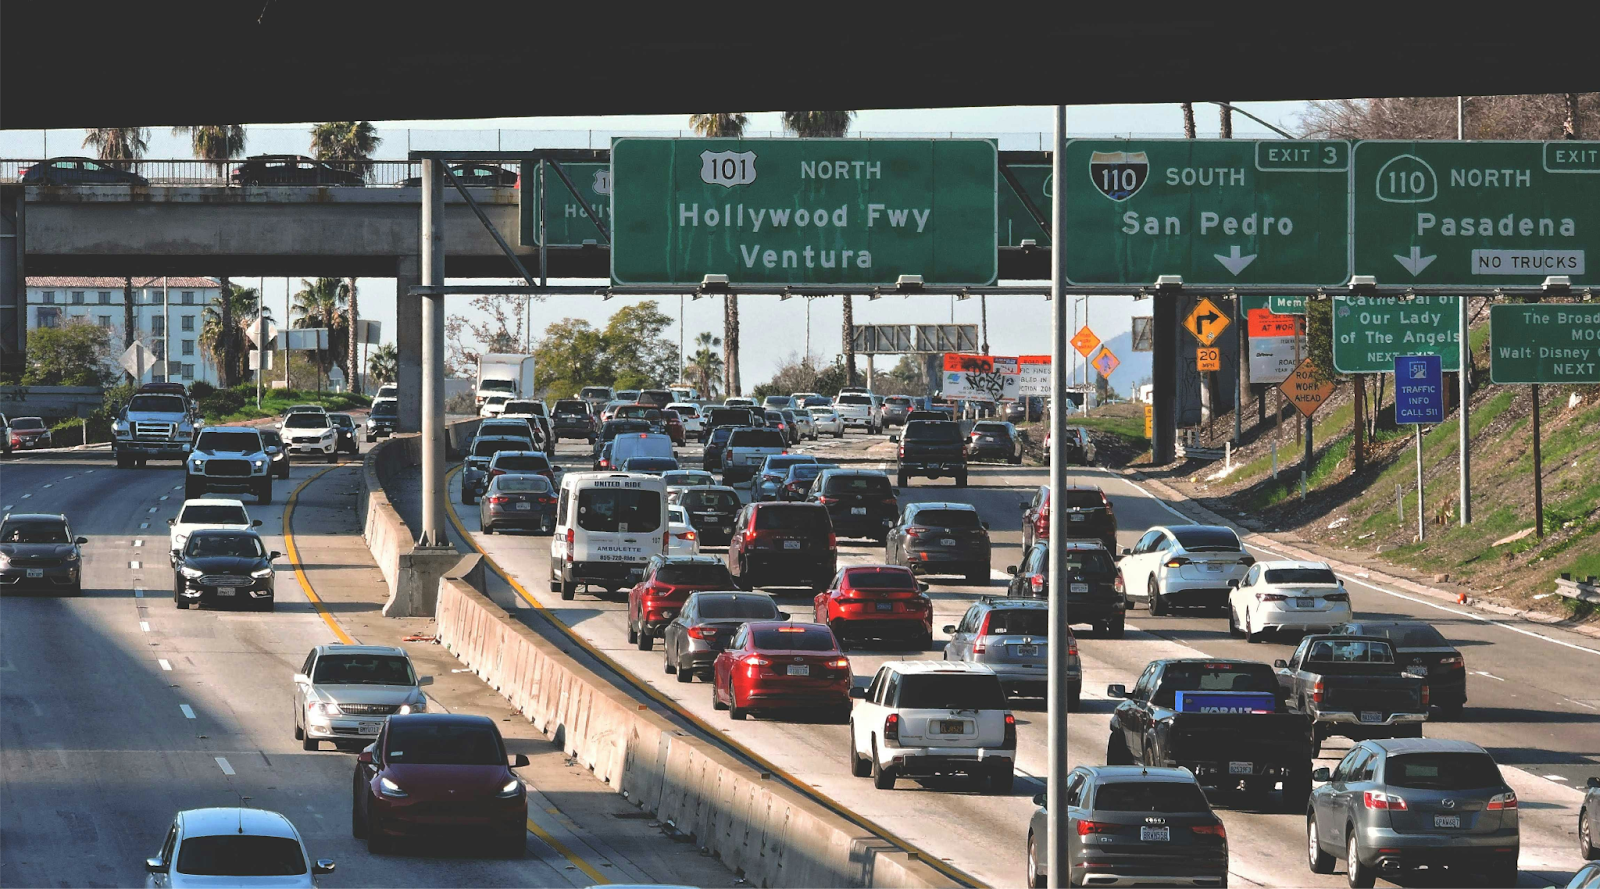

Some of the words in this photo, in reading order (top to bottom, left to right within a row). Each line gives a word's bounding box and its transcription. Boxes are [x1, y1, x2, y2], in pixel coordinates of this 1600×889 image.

[1268, 149, 1310, 162] EXIT
[1323, 147, 1338, 165] 3
[1556, 150, 1597, 163] EXIT
[711, 158, 746, 180] 101
[801, 161, 881, 179] NORTH
[1166, 167, 1245, 186] SOUTH
[1102, 169, 1137, 191] 110
[1389, 171, 1425, 194] 110
[1451, 169, 1531, 187] NORTH
[679, 203, 848, 232] Hollywood
[867, 203, 931, 232] Fwy
[1121, 211, 1181, 235] San
[1200, 211, 1293, 235] Pedro
[1417, 212, 1576, 237] Pasadena
[740, 245, 872, 268] Ventura
[1479, 256, 1502, 269] NO
[1511, 256, 1578, 269] TRUCKS
[1346, 296, 1430, 306] Catheal
[1360, 312, 1390, 325] Our
[1400, 311, 1441, 327] Lady
[1523, 312, 1550, 324] The
[1557, 312, 1600, 324] Broad
[1340, 331, 1356, 344] of
[1365, 331, 1394, 344] The
[1403, 330, 1460, 346] Angels
[1199, 351, 1217, 361] 20
[1499, 347, 1532, 359] Walt
[1540, 347, 1590, 361] Disney
[1296, 371, 1316, 379] ROA
[1554, 363, 1596, 375] NEXT
[1402, 385, 1435, 394] TRAFFIC
[1295, 394, 1321, 402] AHEAD
[1408, 397, 1430, 405] INFO
[1426, 408, 1438, 416] 511
